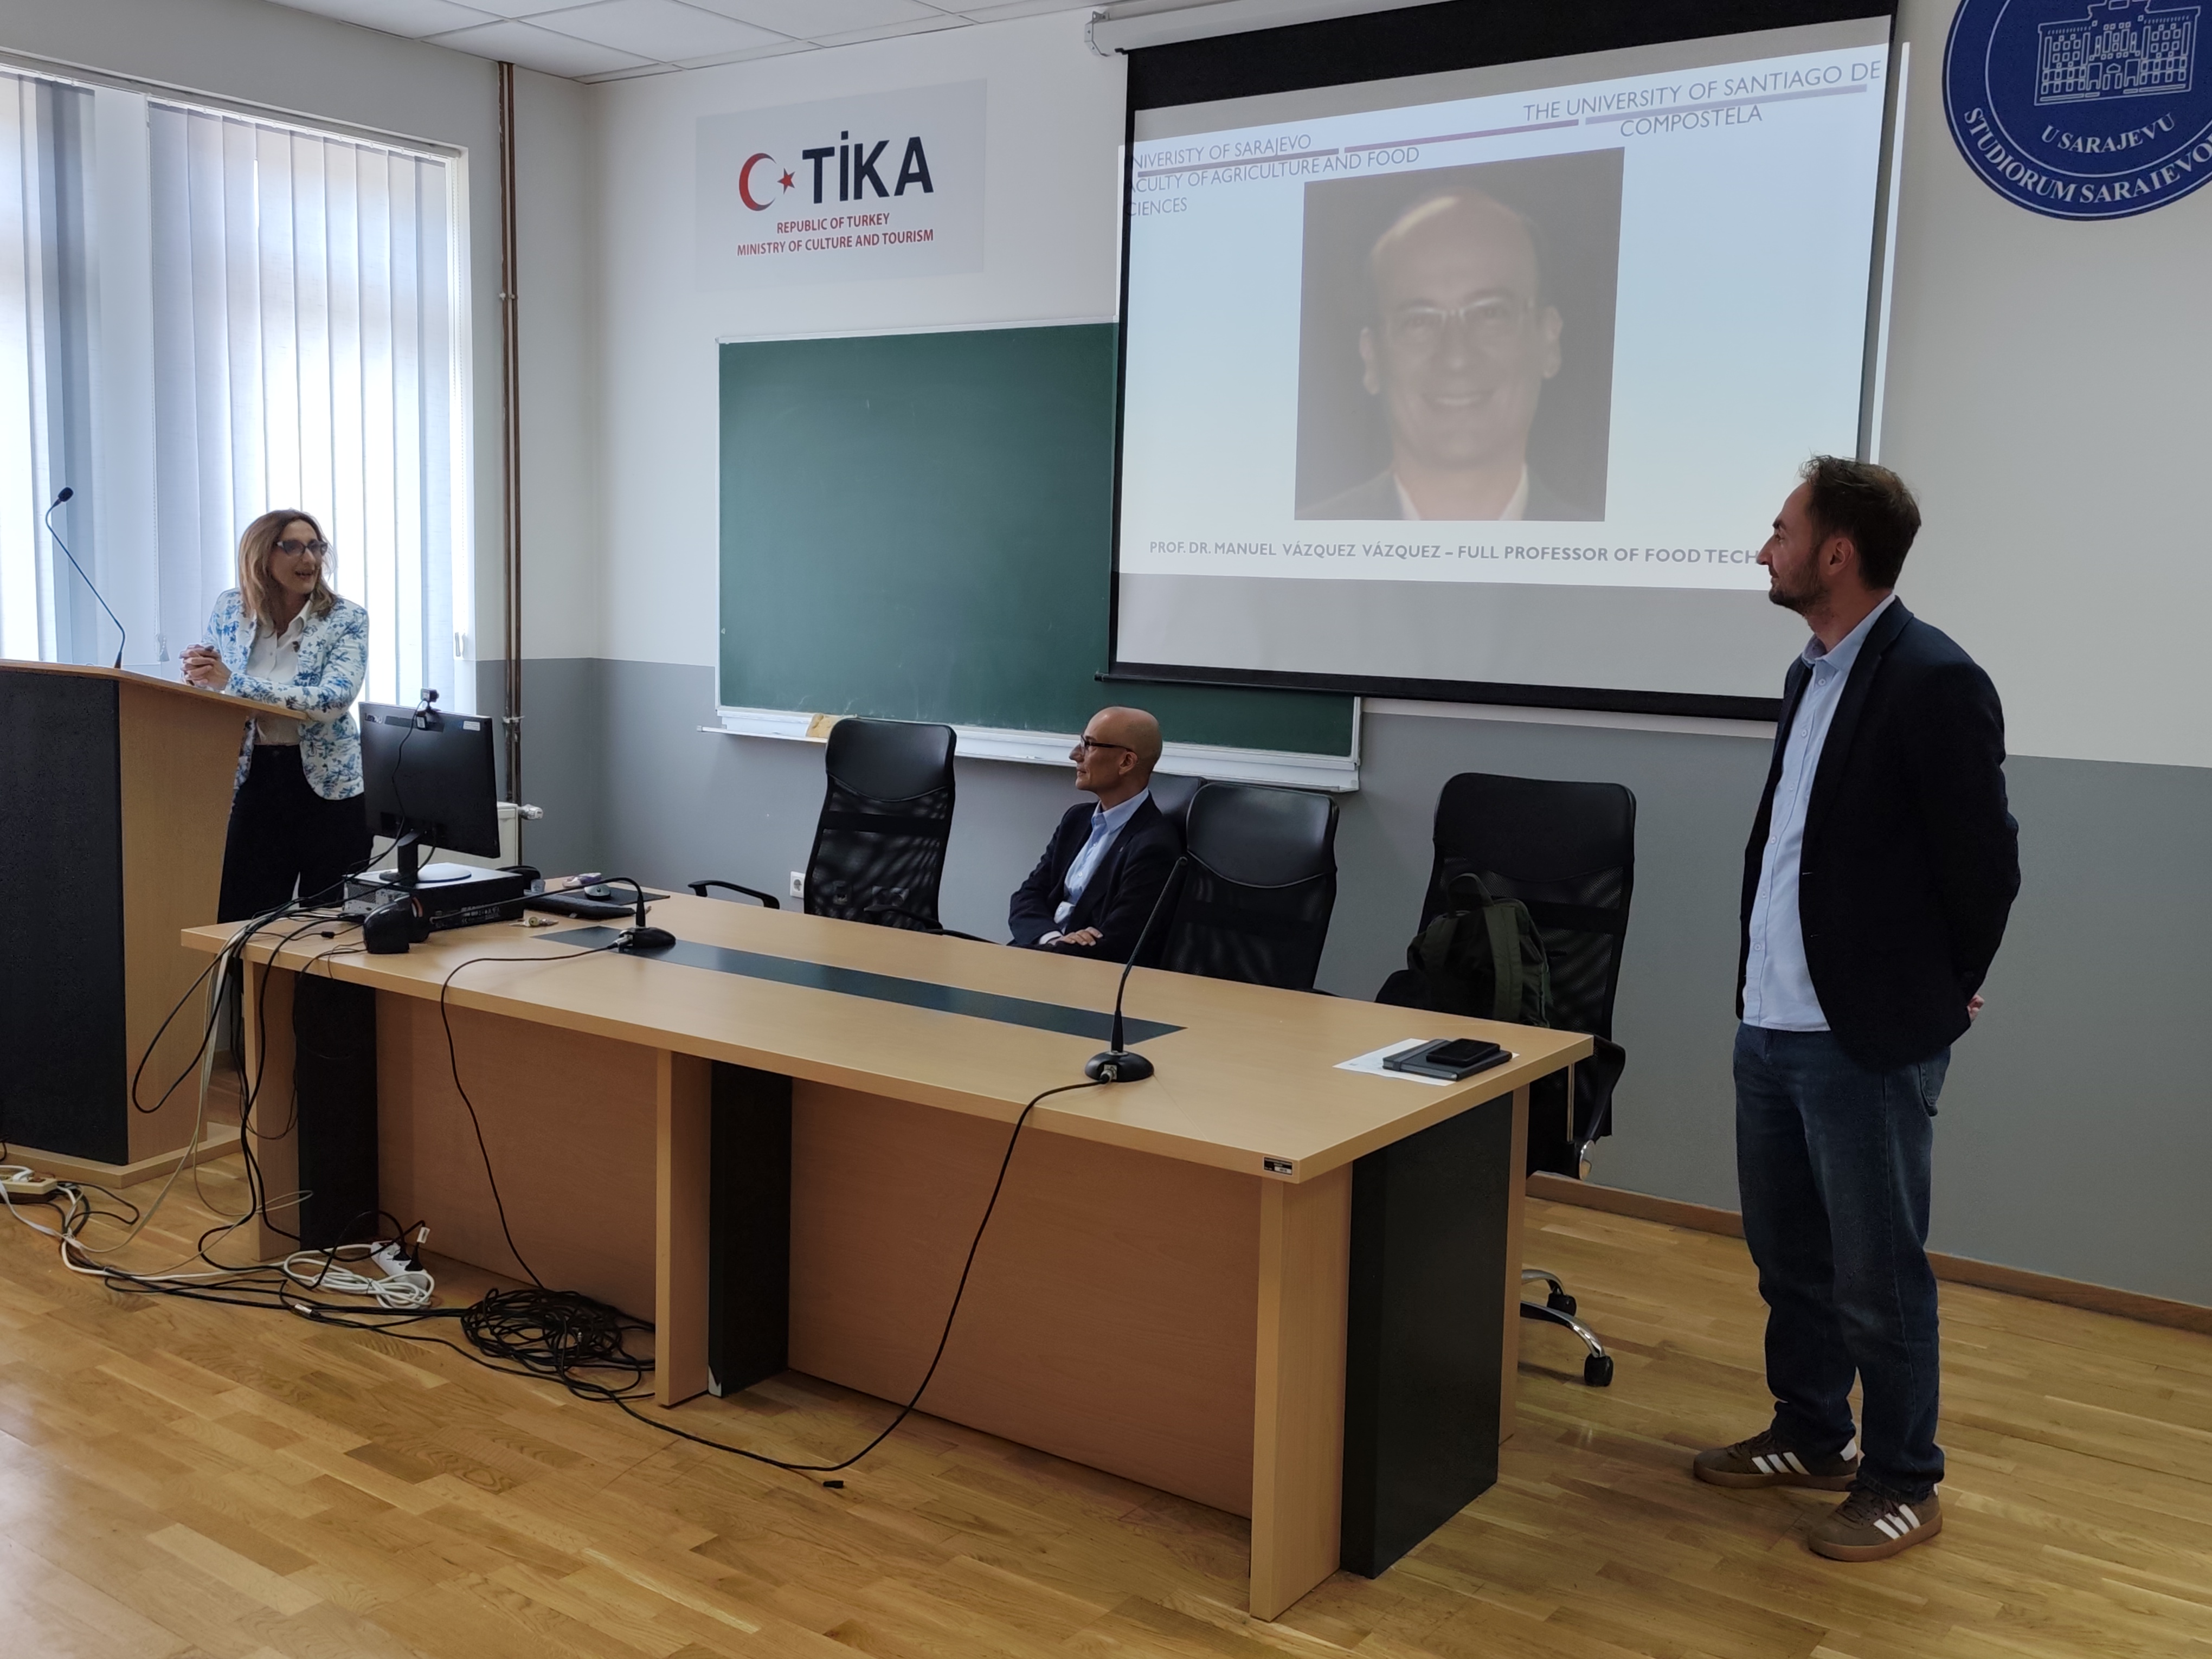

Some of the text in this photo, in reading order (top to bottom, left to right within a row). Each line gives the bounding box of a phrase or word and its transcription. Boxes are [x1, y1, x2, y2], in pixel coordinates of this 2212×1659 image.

[1523, 60, 1881, 122] THE UNIVERSITY OF SANTIAGO DE
[1621, 105, 1762, 137] COMPOSTELA
[2041, 112, 2175, 153] U SARAJEVU
[1210, 144, 1230, 159] OF
[1235, 134, 1311, 157] SARAJEVO
[1964, 107, 2212, 203] STUDIORUM SARAIEVO
[1188, 171, 1208, 187] OF
[1211, 157, 1320, 184] AGRICULTURE
[1322, 153, 1361, 173] AND
[1367, 147, 1419, 167] FOOD
[777, 213, 890, 233] REPUBLIC OF TURKEY
[737, 229, 933, 256] MINISTRY OF CULTURE AND TOURISM
[1149, 541, 1186, 554] PROF.
[1189, 542, 1211, 554] DR.
[1214, 542, 1276, 556] MANUEL
[1282, 541, 1356, 559] VÁZQUEZ
[1362, 541, 1441, 560] VÁZQUEZ
[1458, 545, 1499, 560] FULL
[1504, 546, 1608, 562] PROFESSOR
[1614, 548, 1639, 562] OF
[1645, 548, 1701, 563] FOOD
